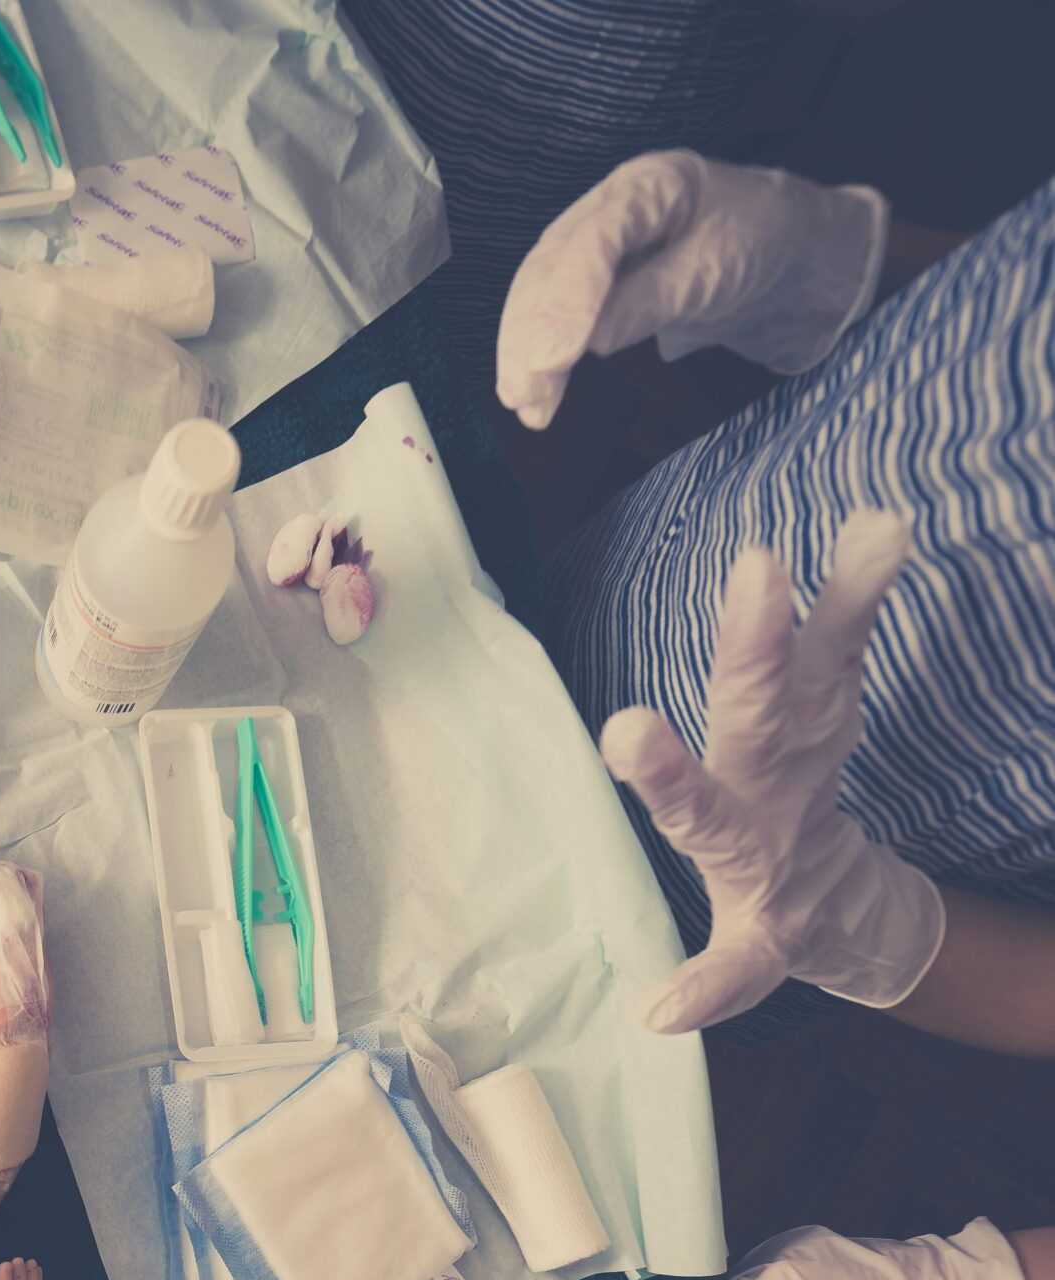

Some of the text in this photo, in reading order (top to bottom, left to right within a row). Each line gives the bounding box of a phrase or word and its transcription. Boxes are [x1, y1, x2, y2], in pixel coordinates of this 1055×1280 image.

[133, 180, 186, 213] Safetac
[182, 170, 235, 202] Safetac
[194, 214, 247, 250] Safetac
